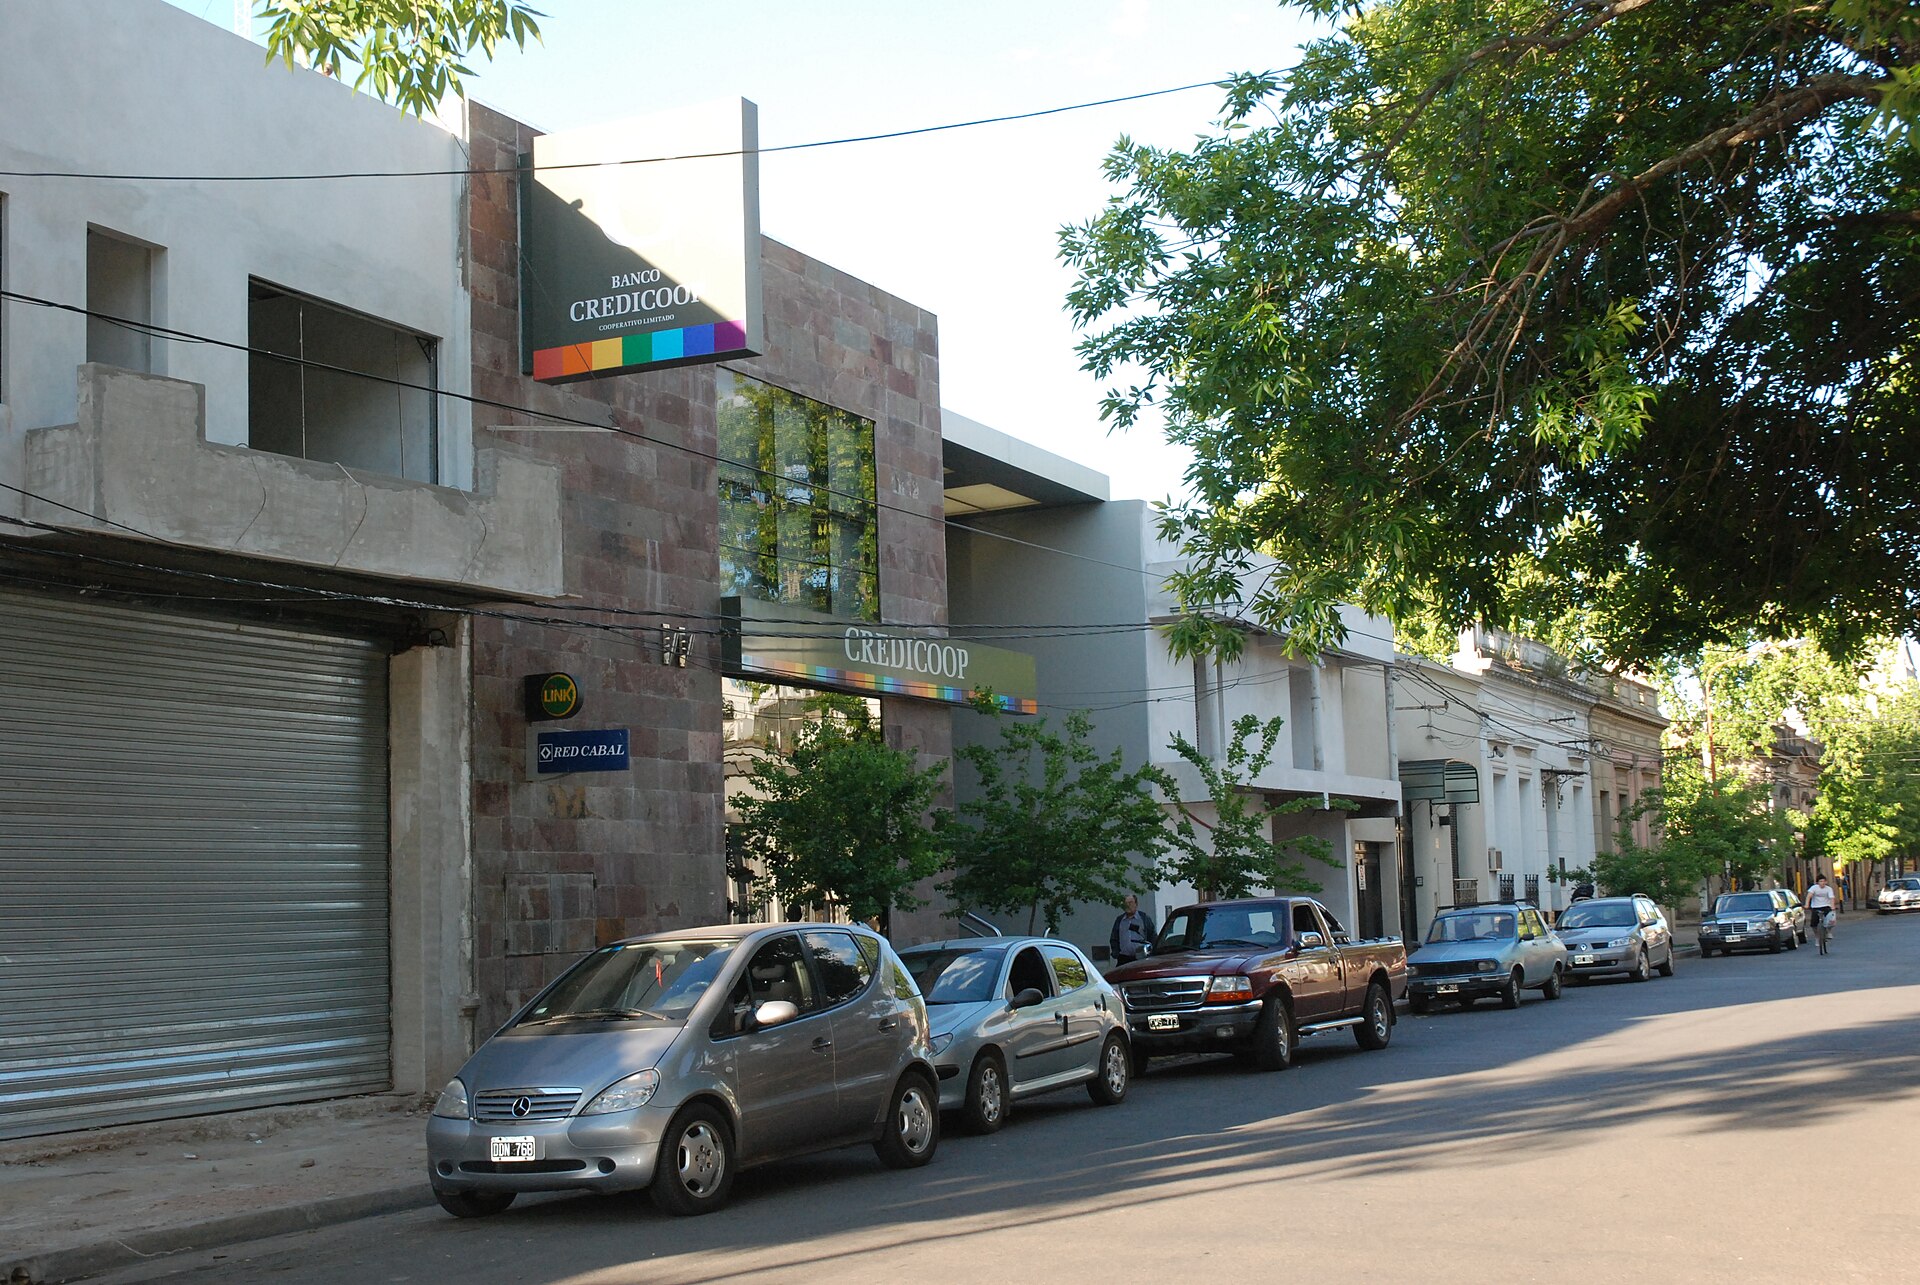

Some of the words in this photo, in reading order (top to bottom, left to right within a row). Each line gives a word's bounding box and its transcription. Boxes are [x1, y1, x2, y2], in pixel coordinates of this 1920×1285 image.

[611, 268, 661, 289] BANCO
[598, 318, 643, 331] COOPERATIVO
[643, 313, 675, 325] LIMITADO
[844, 627, 969, 680] CREDICOOP
[543, 685, 573, 703] LINK
[553, 746, 579, 758] RED
[580, 744, 625, 757] CABAL
[493, 1142, 511, 1157] DDN
[515, 1142, 533, 1156] 768
